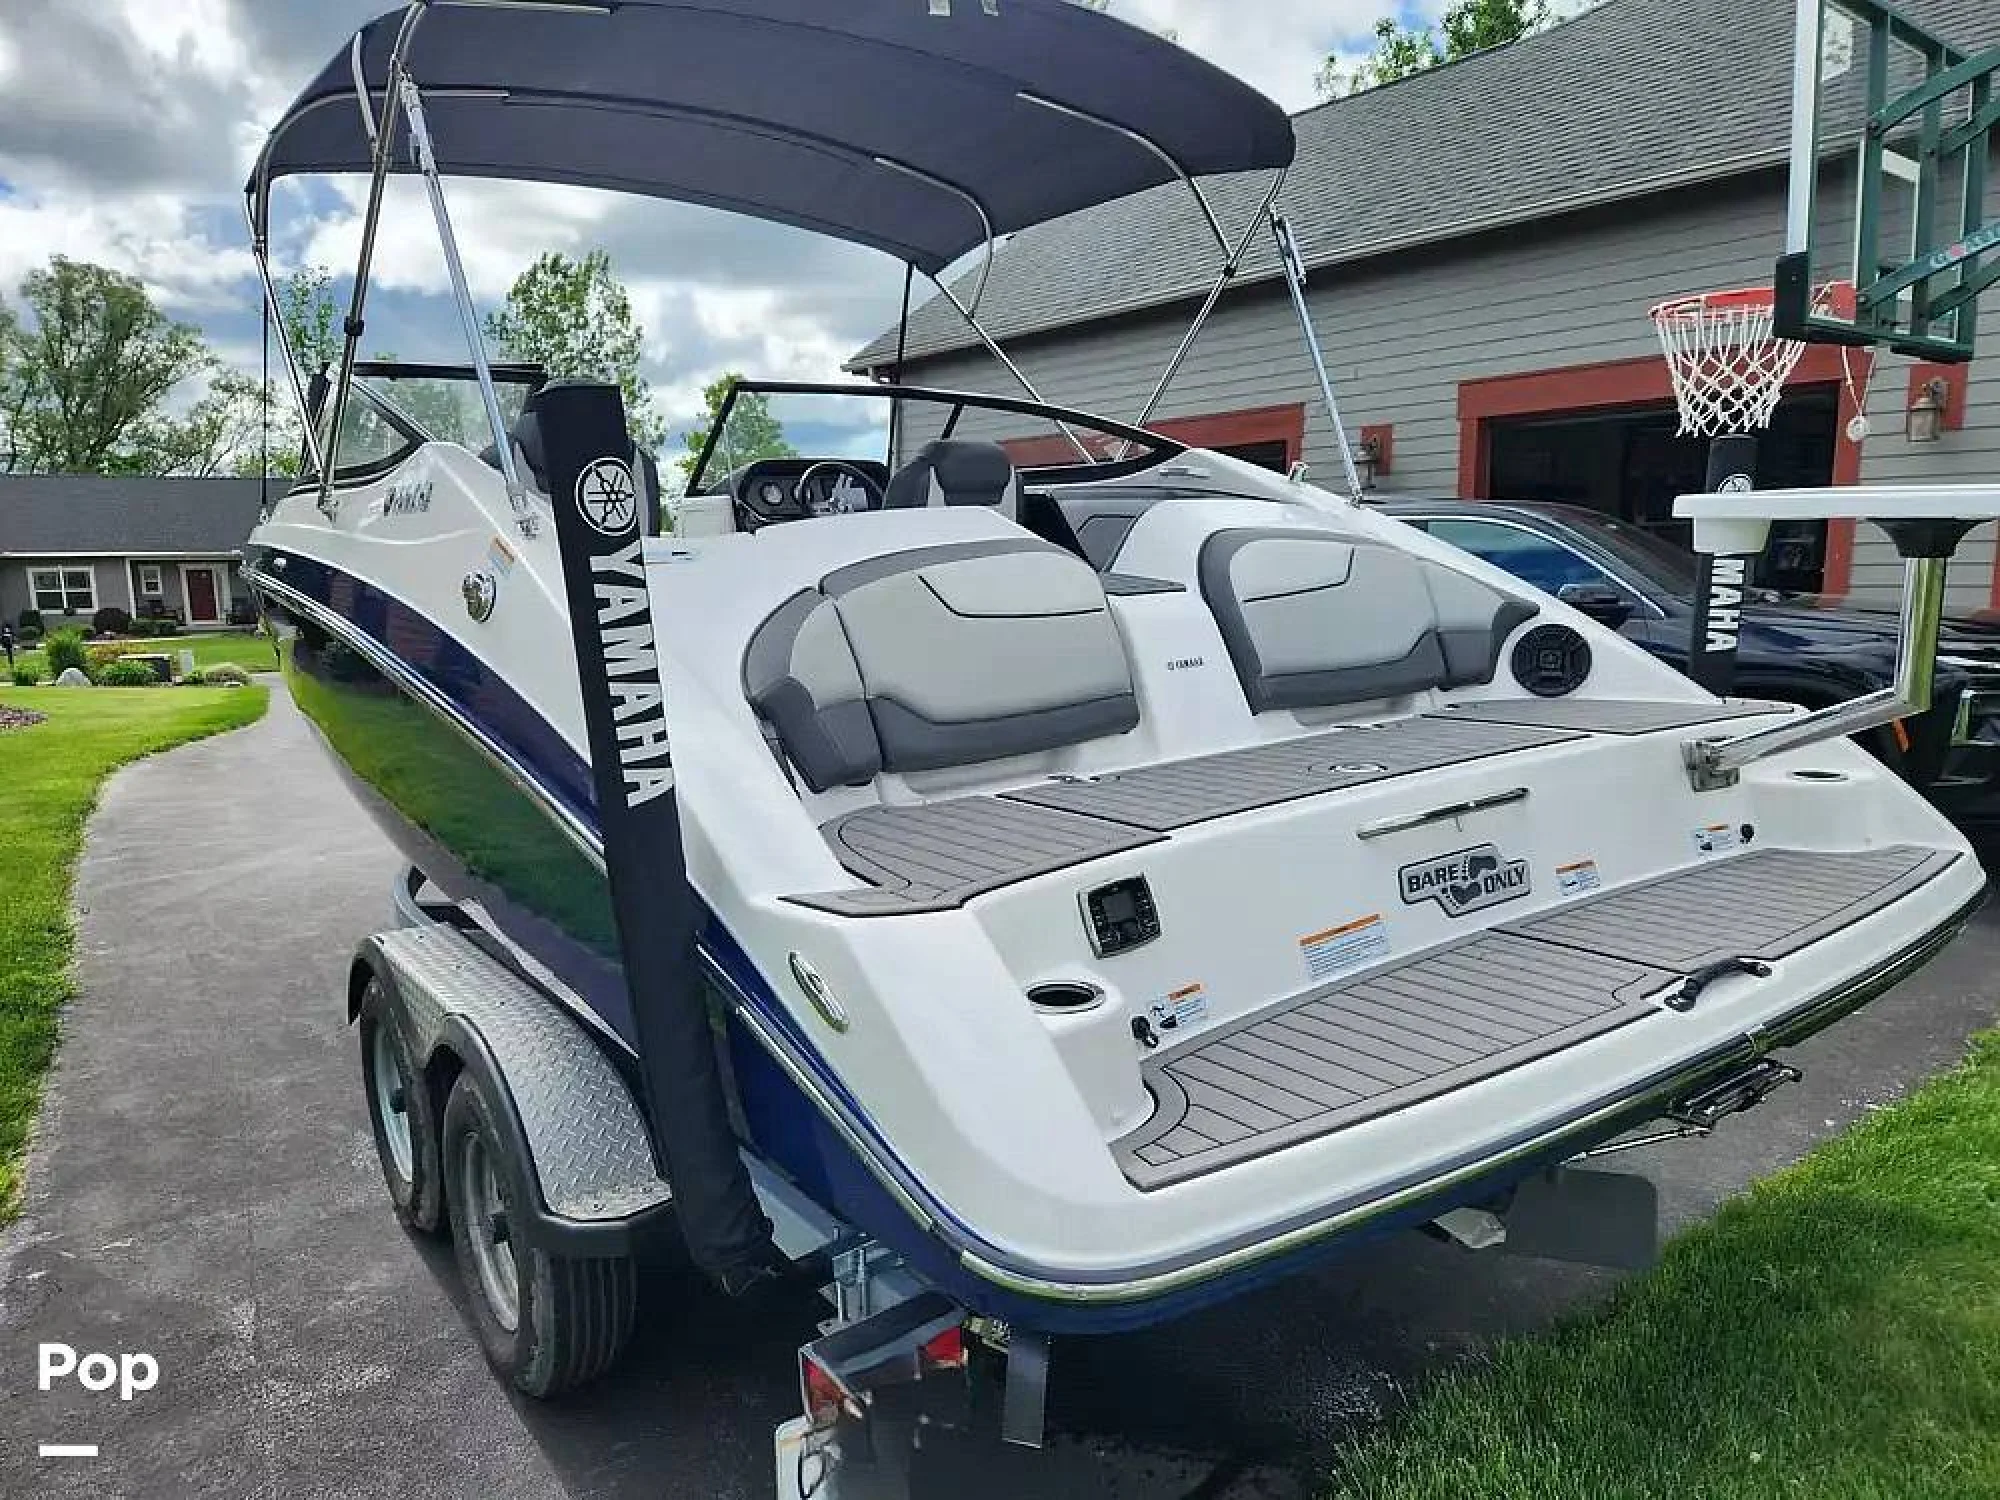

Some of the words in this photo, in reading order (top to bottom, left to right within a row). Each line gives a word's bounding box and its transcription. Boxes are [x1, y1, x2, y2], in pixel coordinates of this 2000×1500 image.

[1705, 553, 1745, 653] MAHA
[589, 538, 675, 809] YAMAHA
[1407, 863, 1459, 893] BARE
[1483, 865, 1525, 894] ONLY
